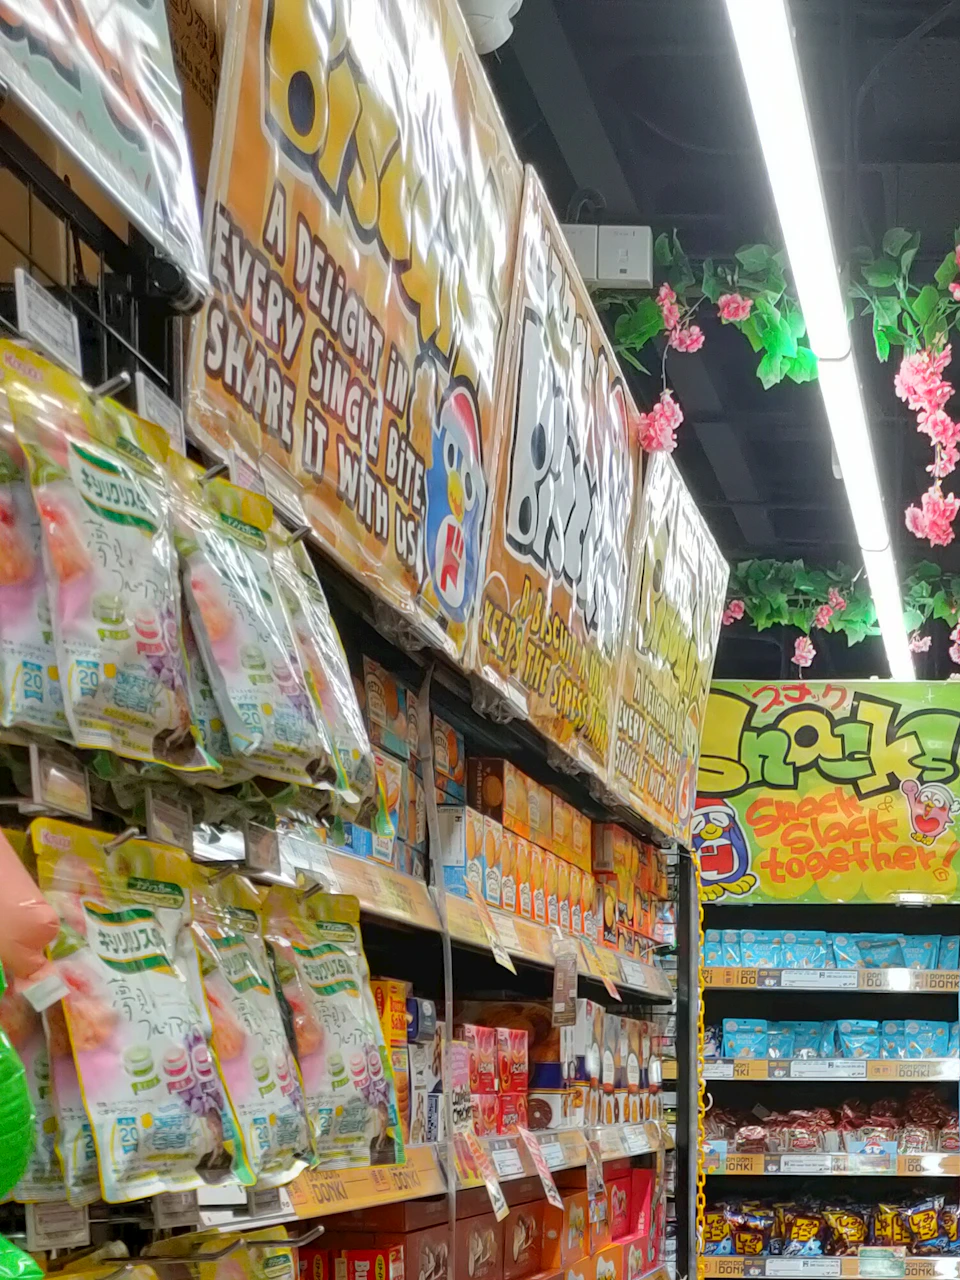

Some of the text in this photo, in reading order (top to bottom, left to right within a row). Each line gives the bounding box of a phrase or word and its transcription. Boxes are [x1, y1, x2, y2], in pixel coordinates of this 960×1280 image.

[263, 180, 286, 266] A
[211, 202, 304, 368] EVERY
[205, 304, 295, 453] SHARE
[481, 600, 524, 678] KEEPS
[521, 640, 551, 700] THE
[745, 786, 865, 838] Snack
[780, 810, 899, 855] Slack
[929, 979, 960, 988] DONK
